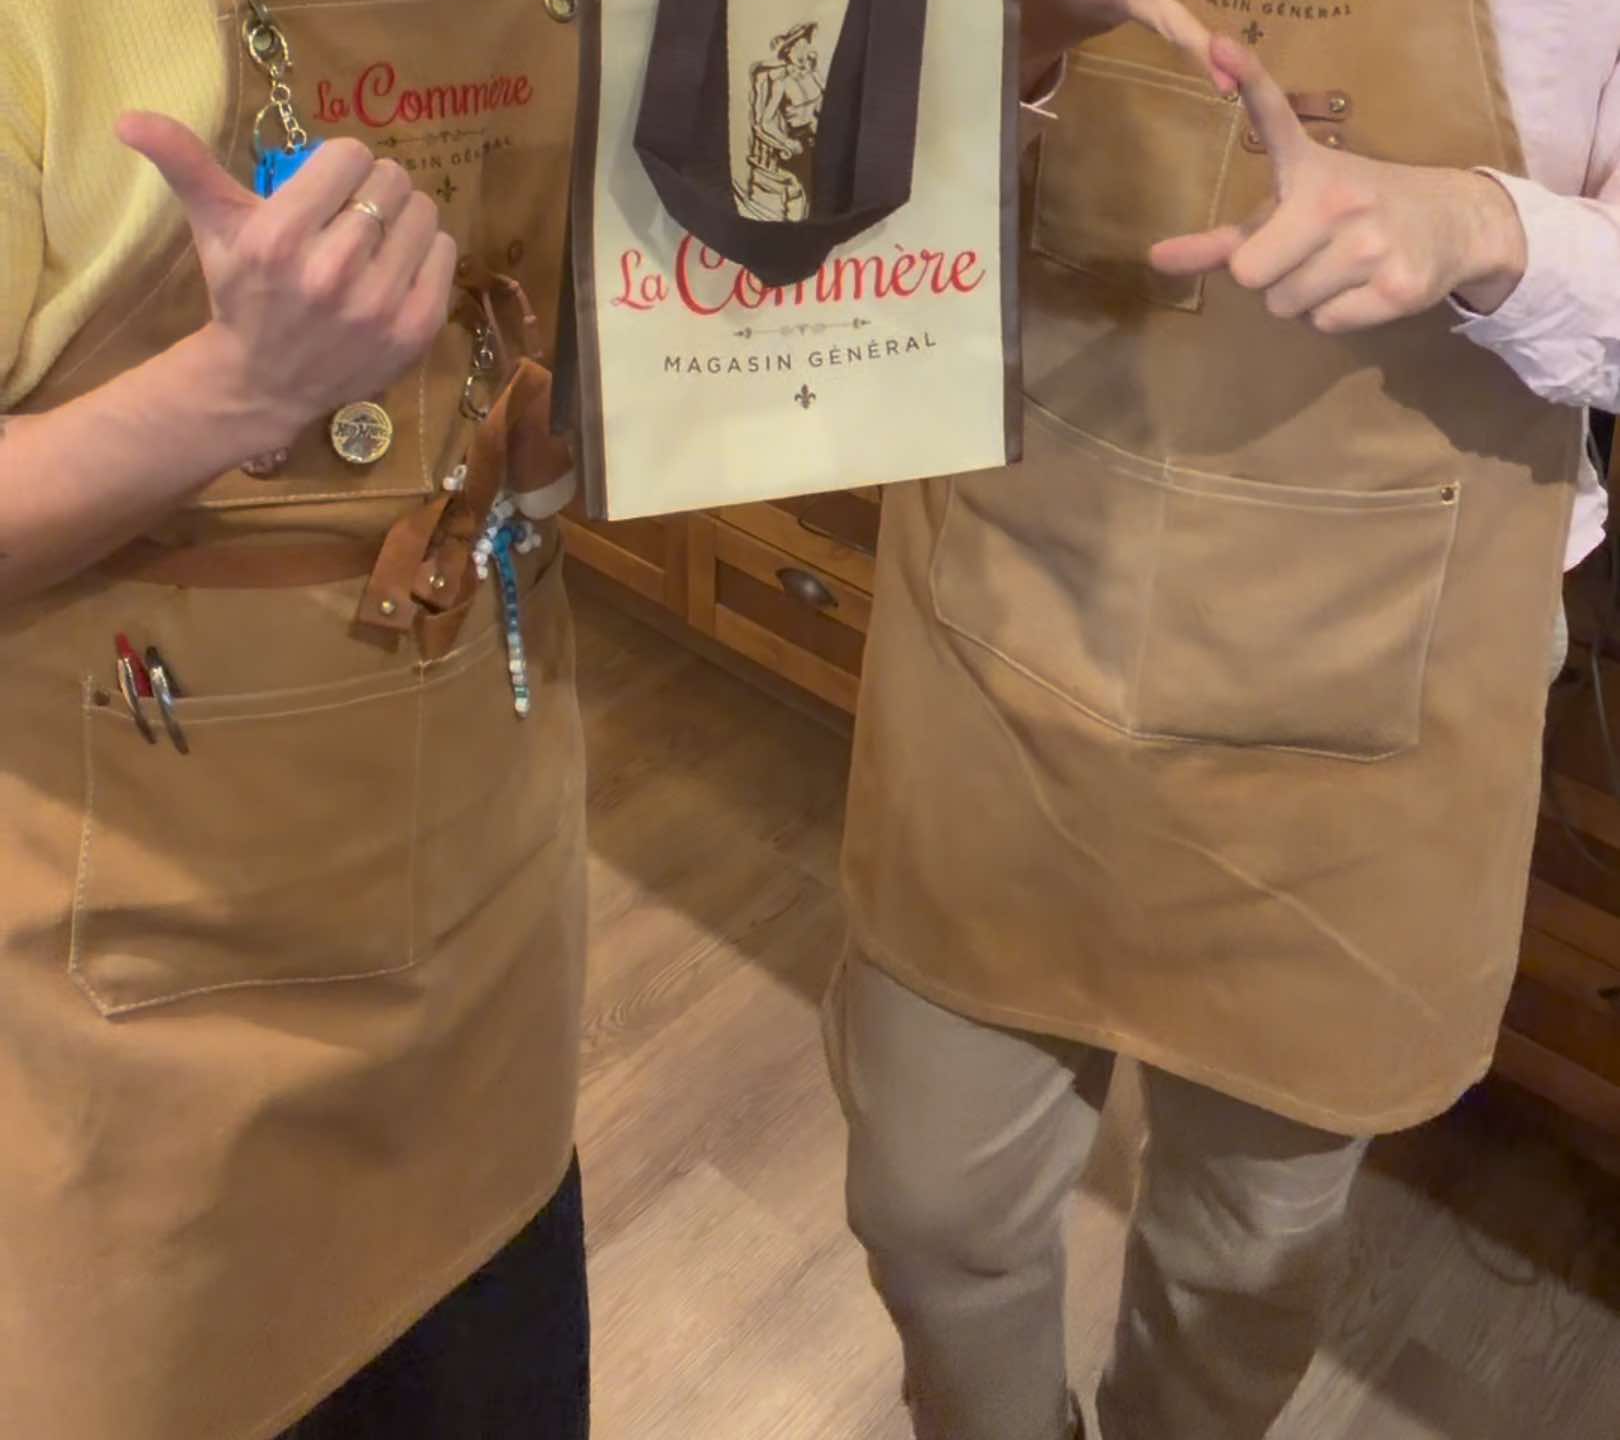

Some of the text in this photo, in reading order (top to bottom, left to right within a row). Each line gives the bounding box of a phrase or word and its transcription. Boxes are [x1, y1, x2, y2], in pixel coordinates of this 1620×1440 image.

[312, 80, 350, 123] La
[609, 248, 669, 311] La
[663, 331, 938, 375] MAGASIN GÉNÉRAL
